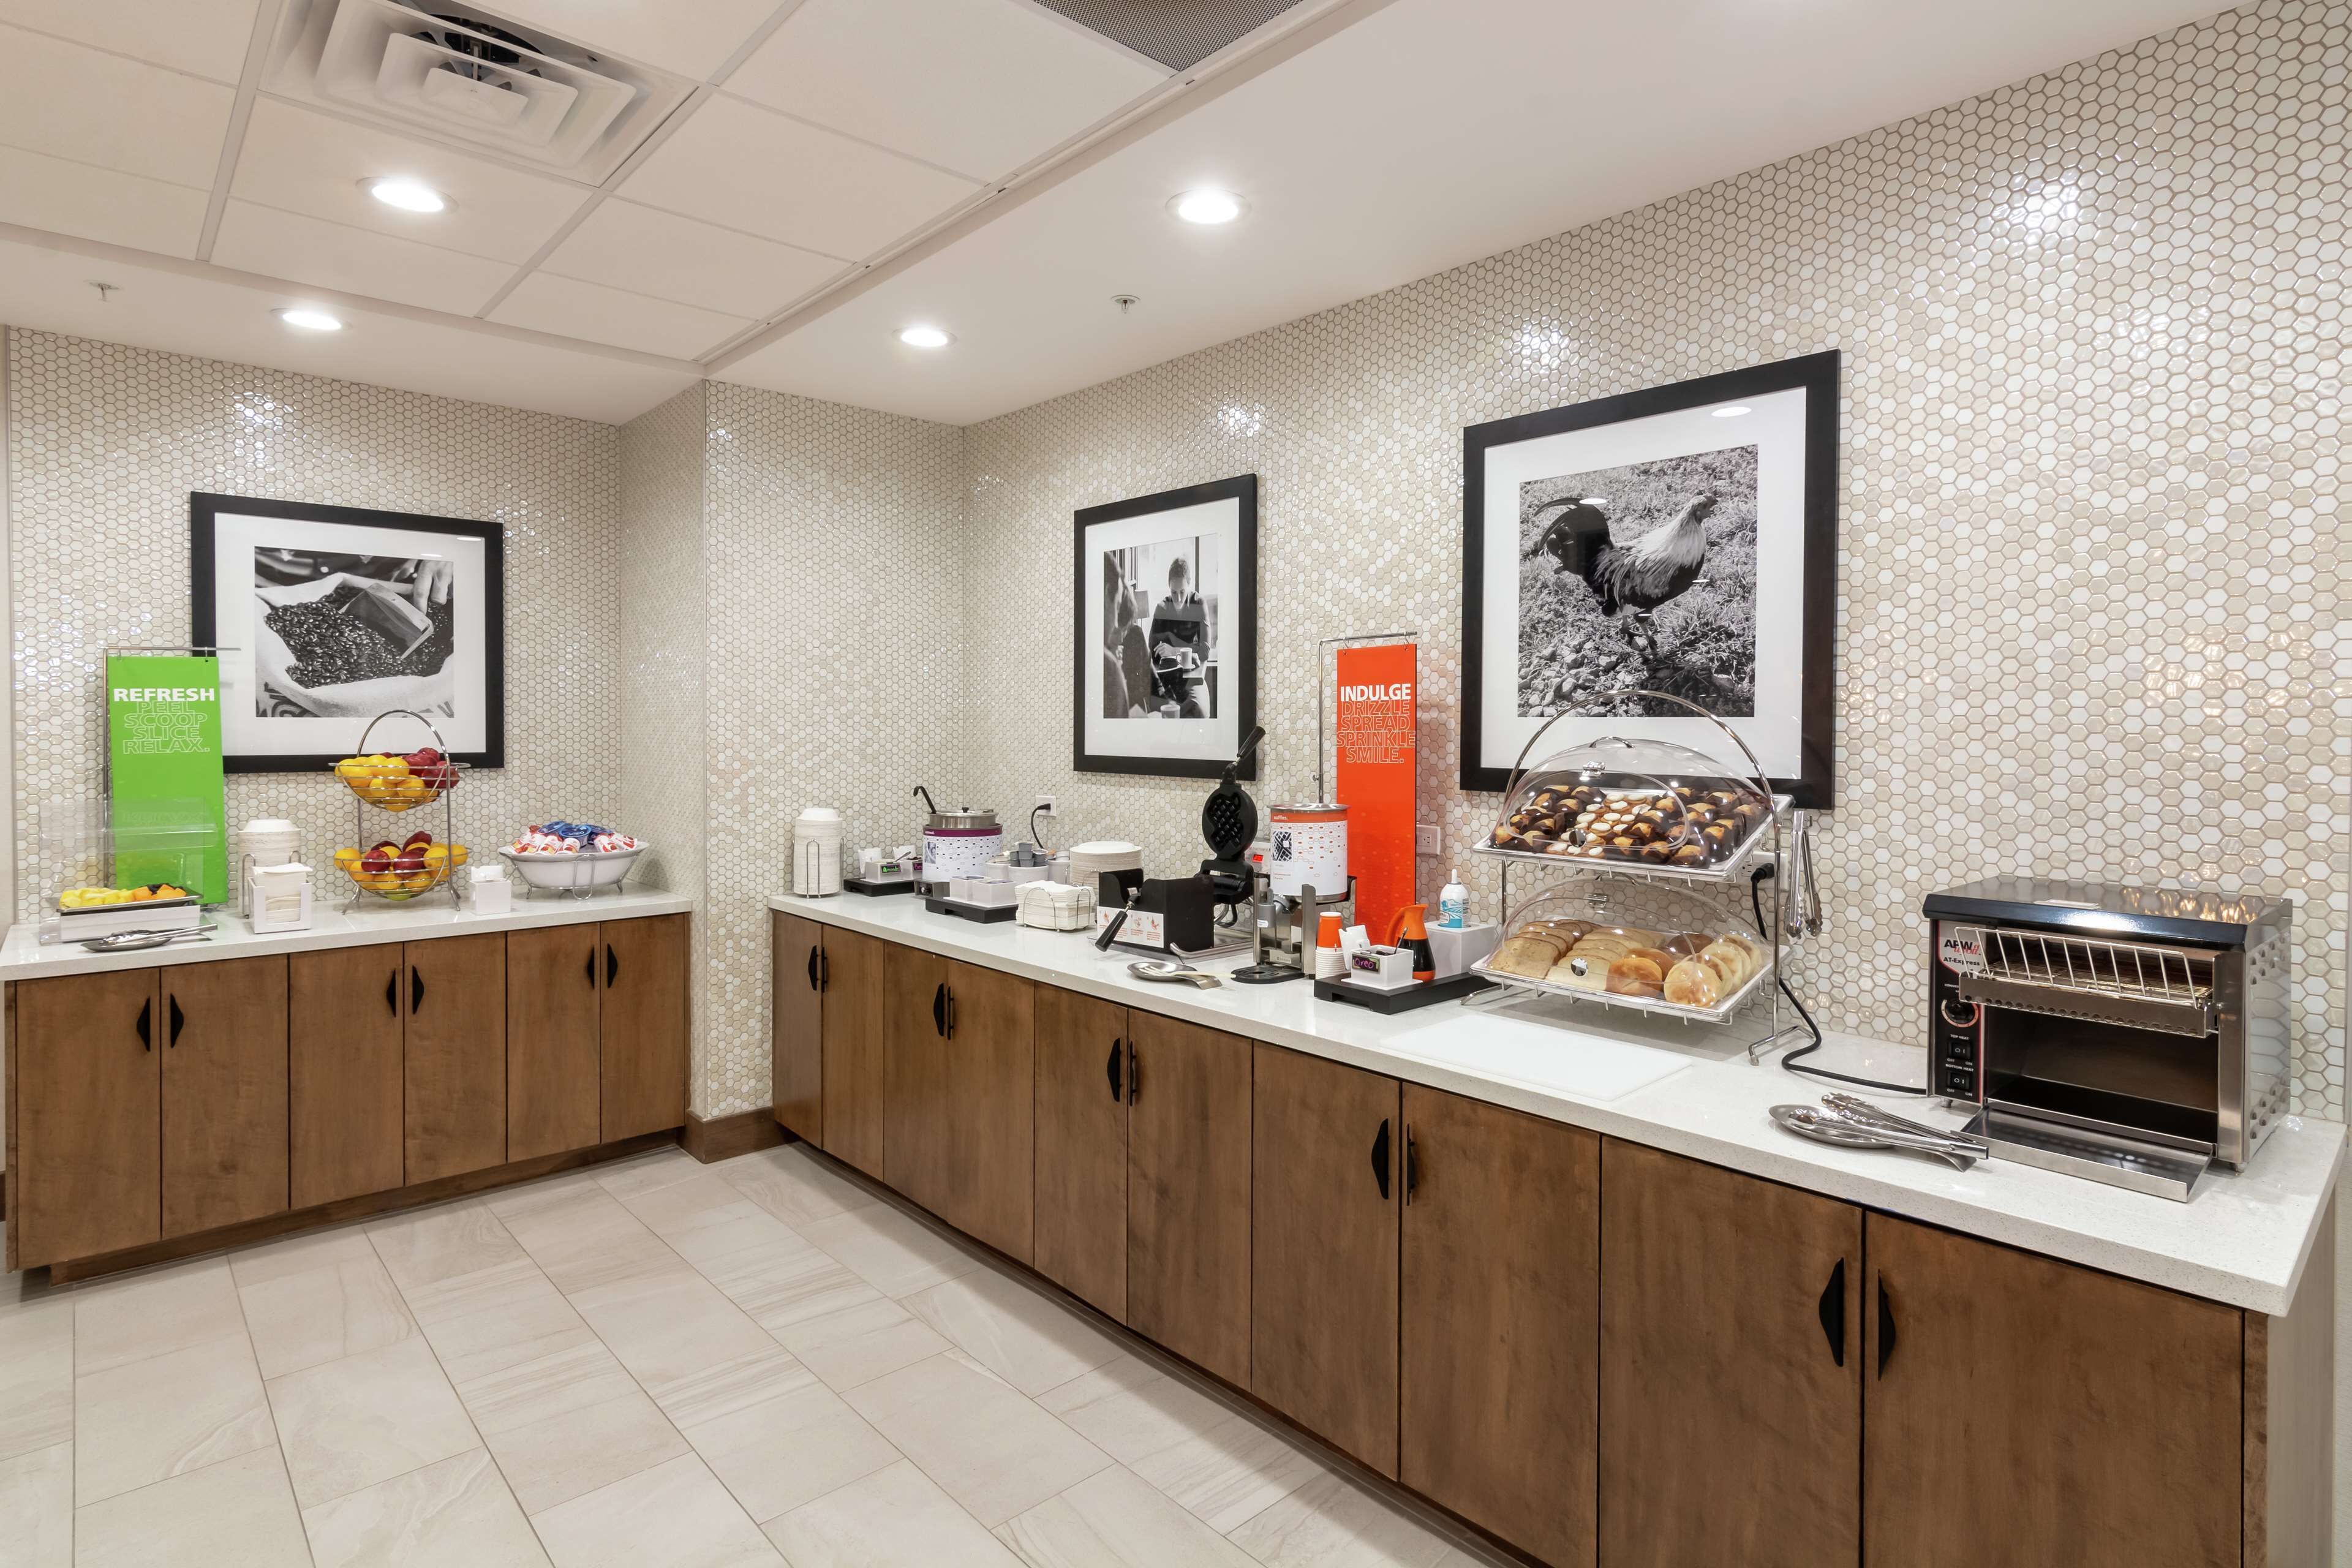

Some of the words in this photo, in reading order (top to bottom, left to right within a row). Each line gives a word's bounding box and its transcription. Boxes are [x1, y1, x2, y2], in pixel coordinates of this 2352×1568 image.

[113, 688, 214, 702] REFRESH
[1340, 684, 1411, 701] INDULGE
[137, 700, 195, 714] PEEL
[1341, 699, 1410, 716] DRIZZLE
[124, 712, 208, 728] SCOOP
[1341, 715, 1411, 732] SPREAD
[133, 726, 200, 741] SLICE
[1336, 730, 1415, 748] SPRINKLE
[123, 738, 211, 755] RELAX.
[1346, 747, 1404, 764] SMILE.
[1944, 939, 1973, 950] APW
[1355, 957, 1374, 969] Oreo
[1943, 957, 1980, 966] AT-Express
